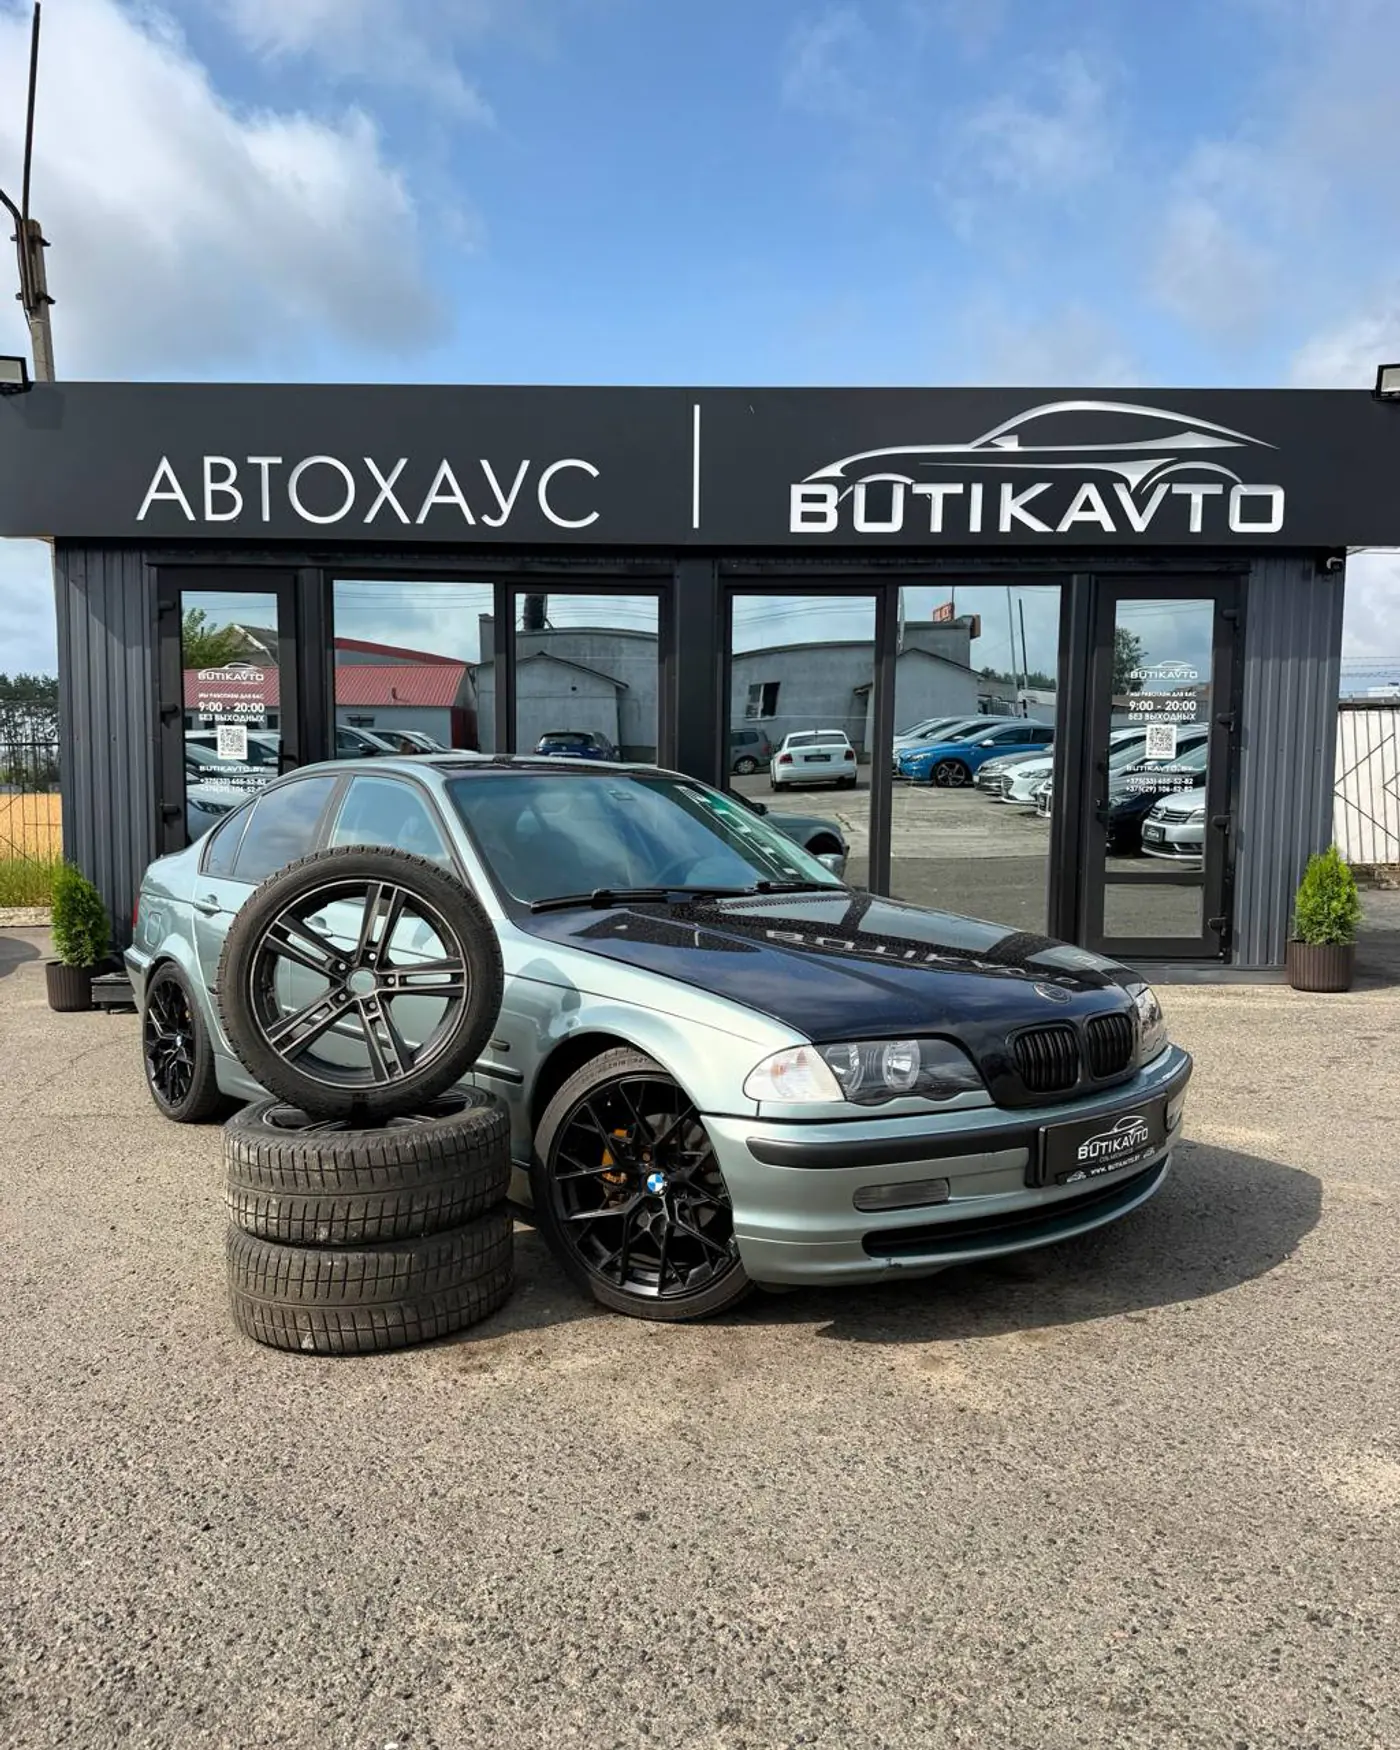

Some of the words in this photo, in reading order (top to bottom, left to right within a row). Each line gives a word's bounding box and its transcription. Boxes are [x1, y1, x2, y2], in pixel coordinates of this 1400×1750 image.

[136, 455, 601, 529] АВТОХАУС
[789, 482, 1286, 534] BUTIKAVTO
[198, 671, 264, 681] BUTIKAVTO
[1130, 670, 1198, 680] BUTIKAVTO
[198, 701, 223, 712] 9:00
[233, 702, 265, 713] 20:00
[1129, 700, 1154, 711] 9:00
[1165, 700, 1197, 711] 20:00
[1144, 712, 1196, 721] ВЫХОДНЫХ
[1078, 1127, 1149, 1160] BUTIKAVTO
